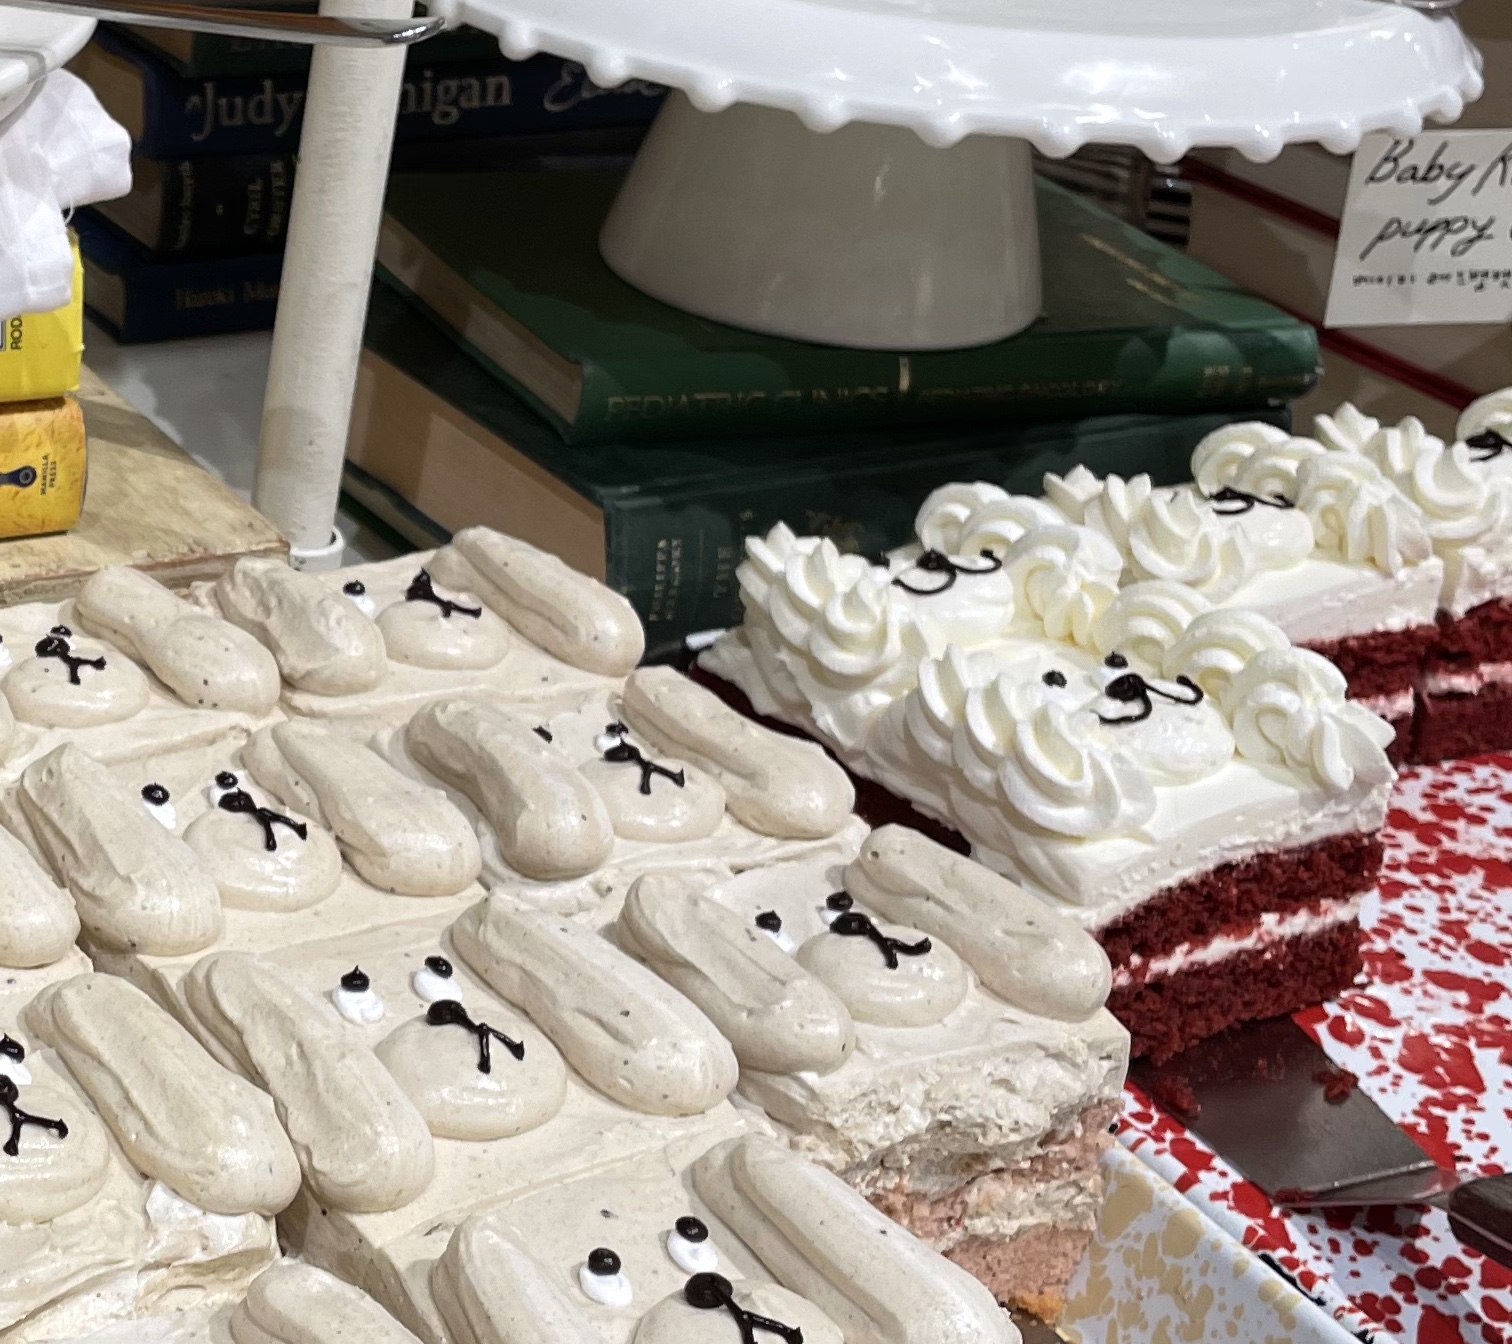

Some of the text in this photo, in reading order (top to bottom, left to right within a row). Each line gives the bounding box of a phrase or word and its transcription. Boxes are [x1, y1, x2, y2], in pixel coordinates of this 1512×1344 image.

[184, 76, 303, 143] Judy
[400, 69, 512, 126] nigan
[1364, 138, 1476, 205] Baby
